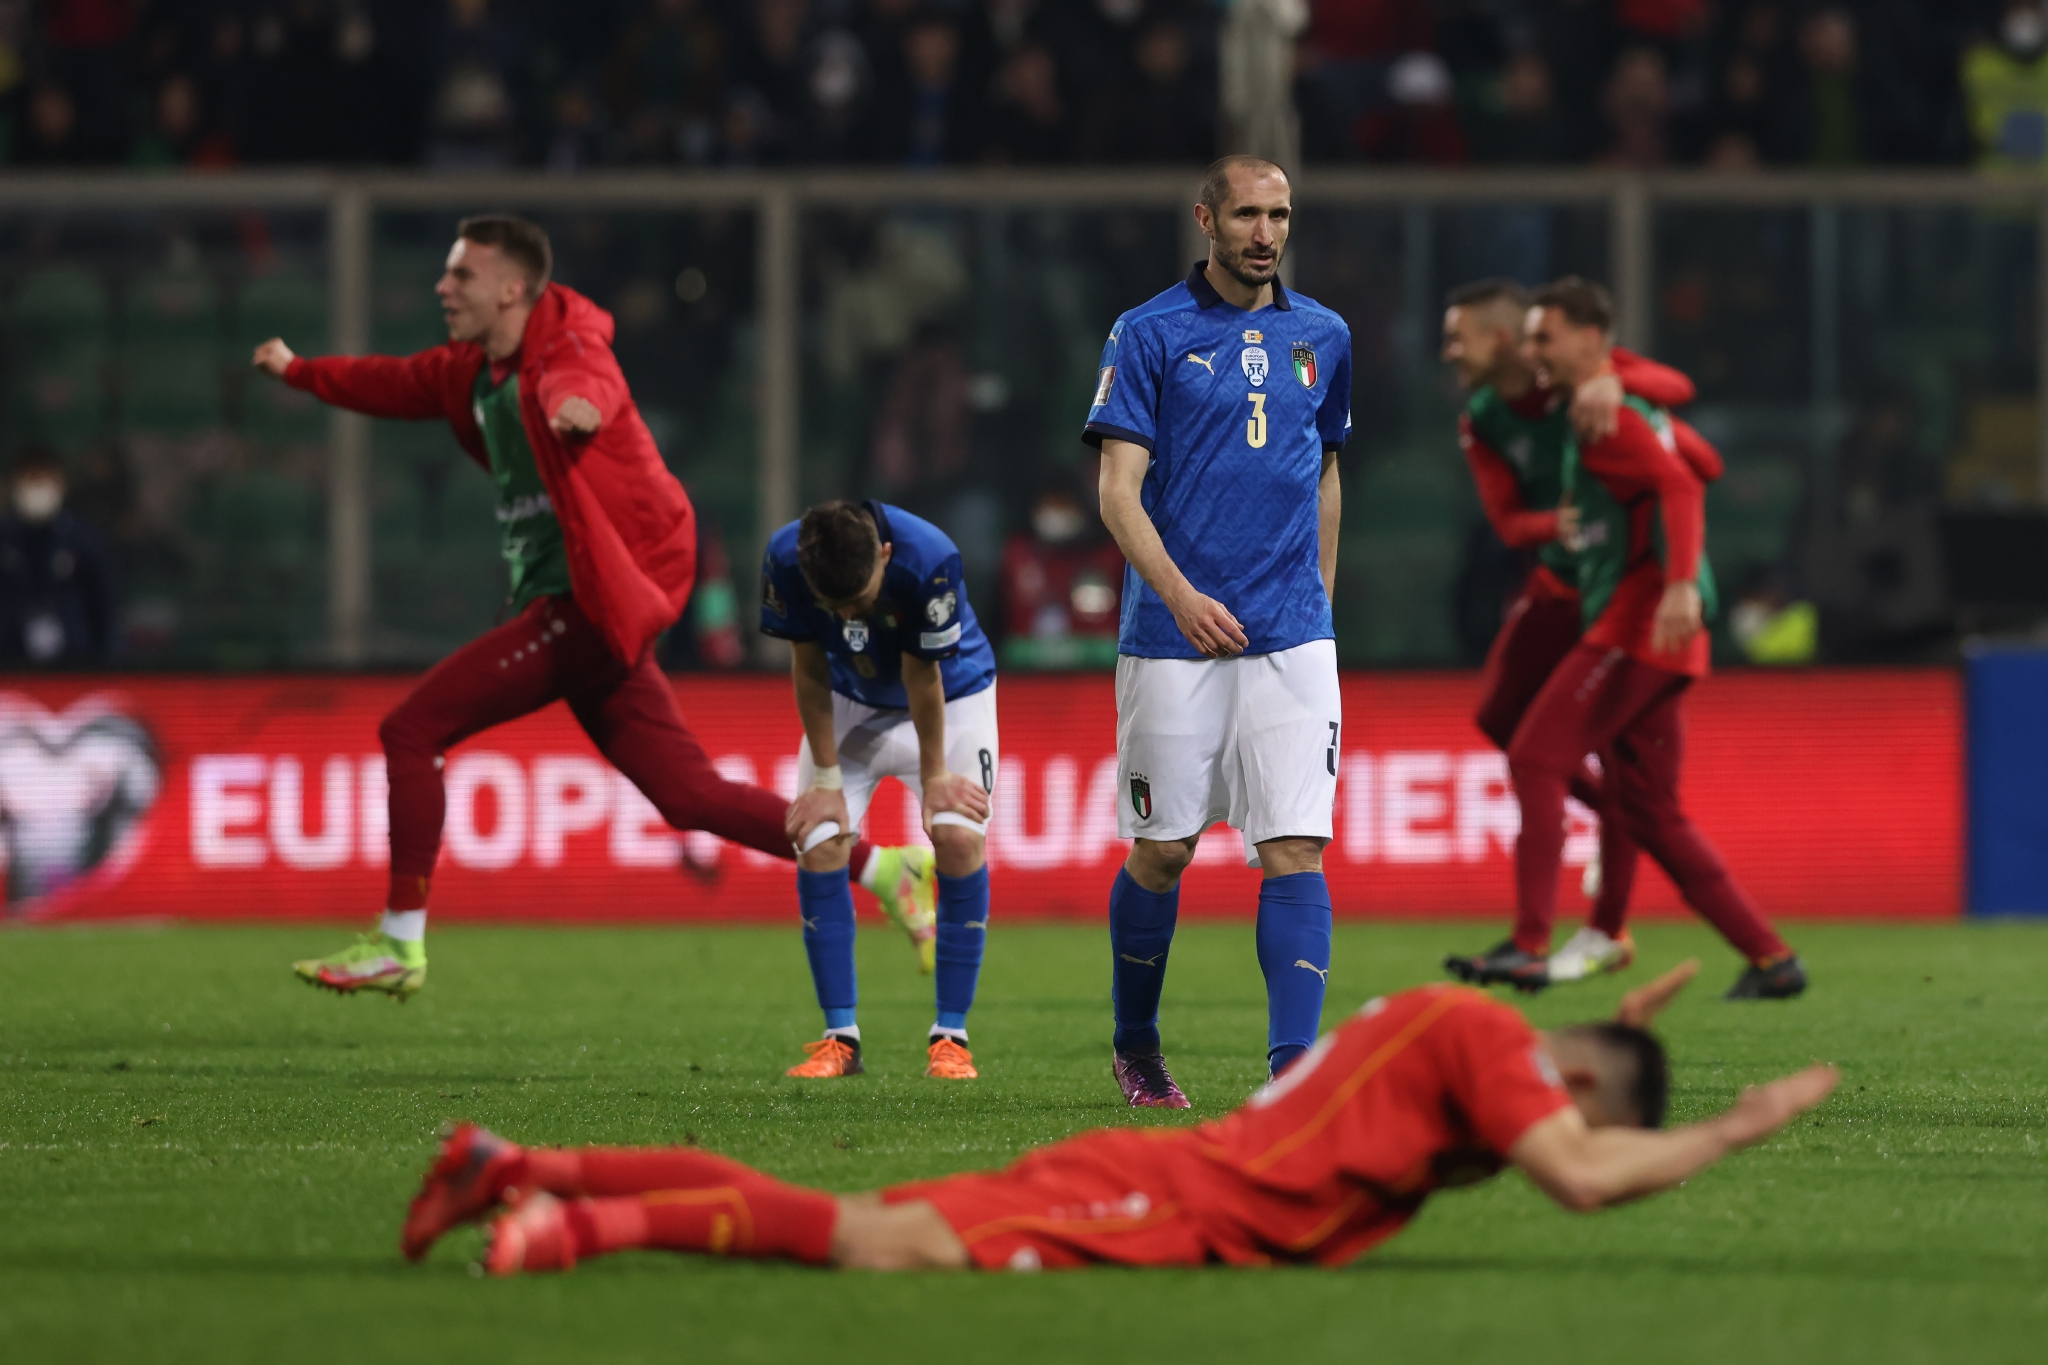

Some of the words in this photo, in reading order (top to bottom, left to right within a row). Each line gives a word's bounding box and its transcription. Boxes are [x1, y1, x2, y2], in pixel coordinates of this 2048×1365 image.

[1293, 350, 1313, 360] ITALIA
[1246, 393, 1268, 449] 3
[978, 747, 993, 796] 8
